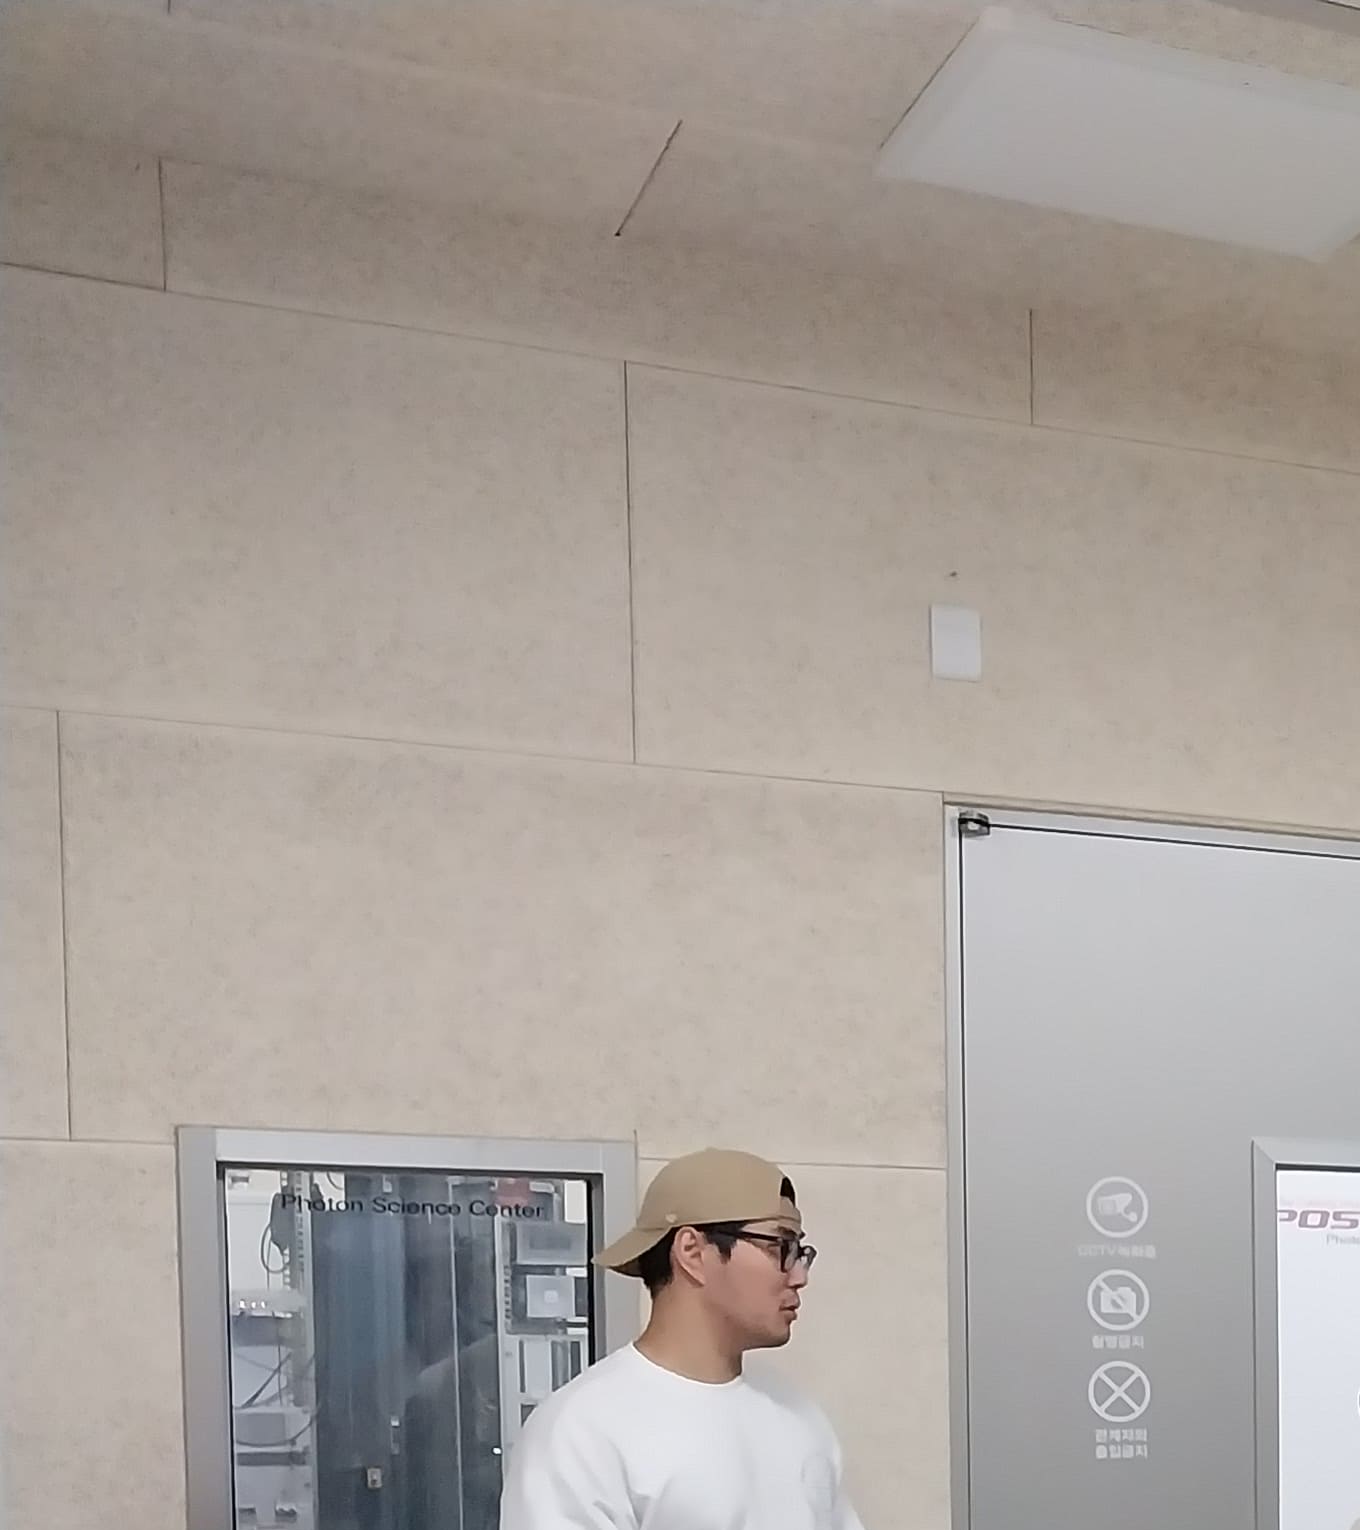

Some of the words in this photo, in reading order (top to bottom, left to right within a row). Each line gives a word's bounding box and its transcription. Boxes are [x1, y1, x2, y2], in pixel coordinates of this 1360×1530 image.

[281, 1194, 363, 1212] Photon
[372, 1196, 460, 1216] Science
[469, 1199, 544, 1218] Center
